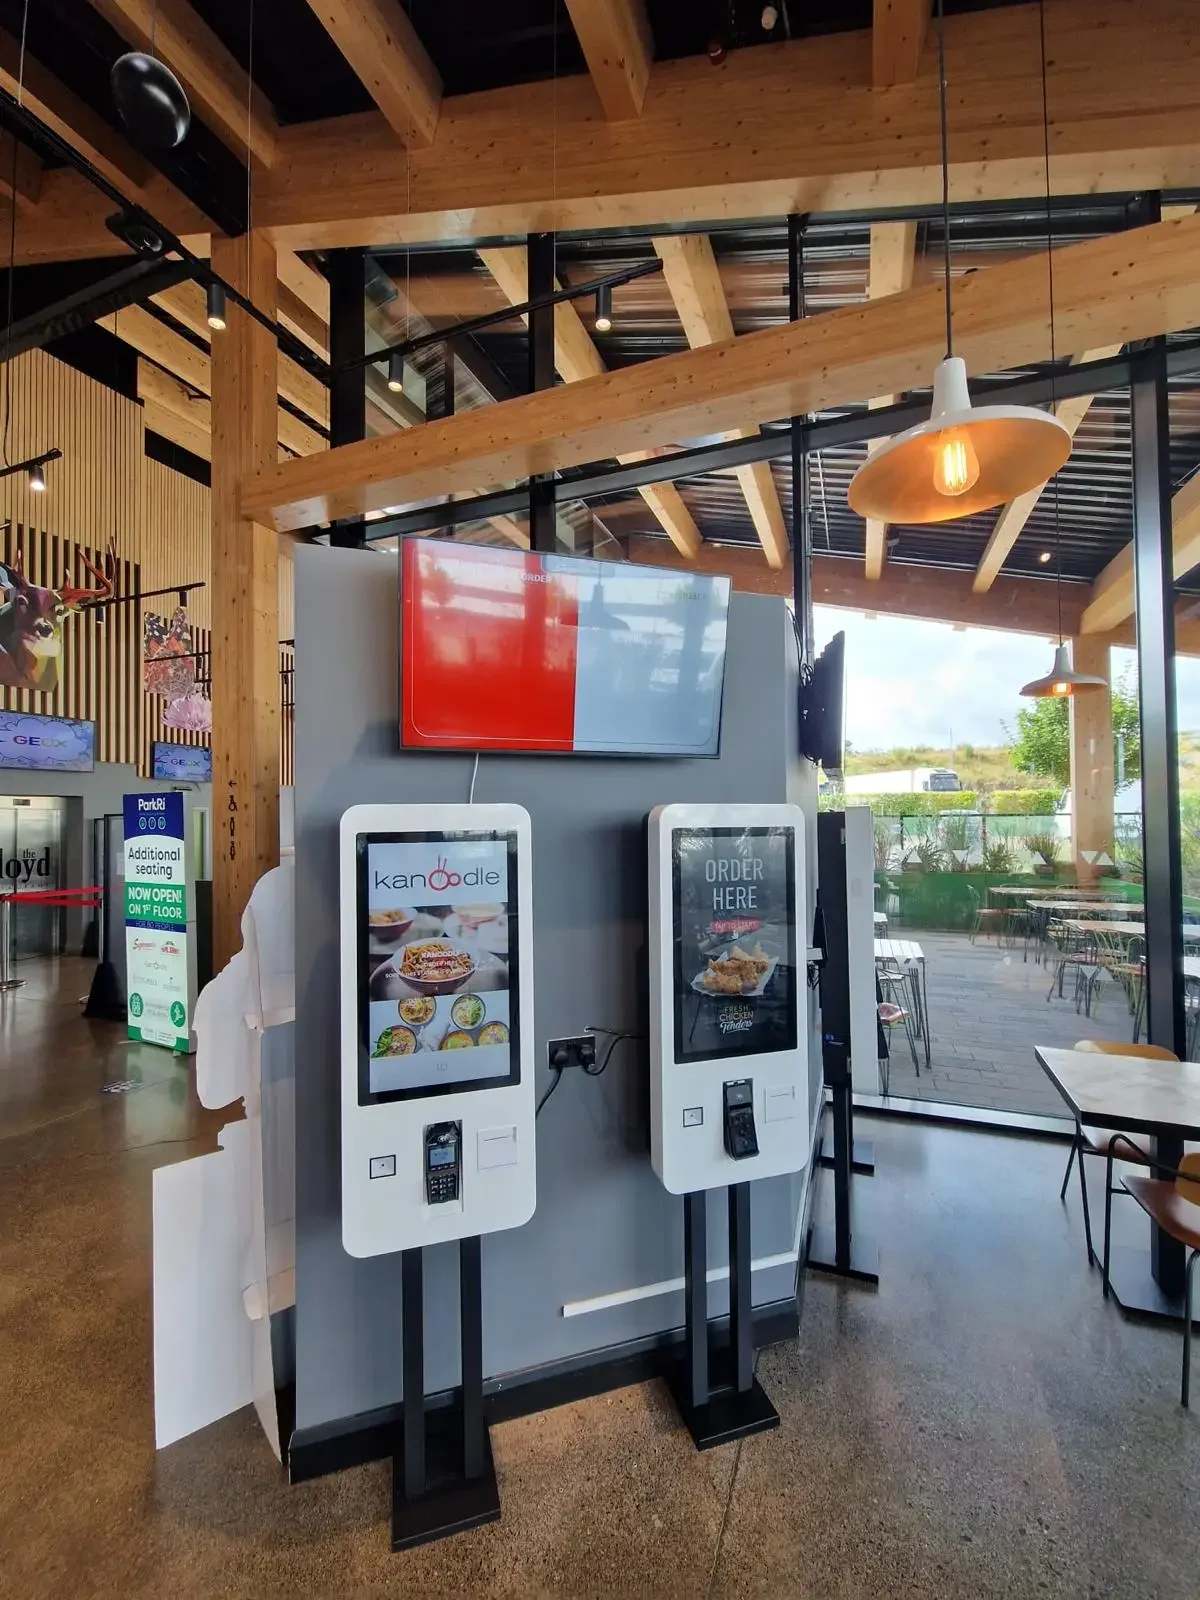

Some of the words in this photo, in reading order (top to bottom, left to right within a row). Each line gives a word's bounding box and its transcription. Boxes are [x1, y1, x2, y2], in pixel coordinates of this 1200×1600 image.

[13, 735, 68, 748] GEOX
[22, 848, 36, 859] the
[128, 846, 181, 861] Additional
[135, 862, 173, 880] seating
[374, 860, 501, 892] kanoodle
[705, 858, 764, 882] ORDER
[128, 886, 151, 901] NOW
[152, 888, 182, 903] OPEN!
[713, 885, 757, 910] HERE
[128, 903, 141, 915] ON
[153, 905, 183, 919] FLOOR
[719, 1010, 754, 1022] CHICKEN
[724, 1004, 749, 1013] FRESH
[719, 1019, 753, 1034] Tenders
